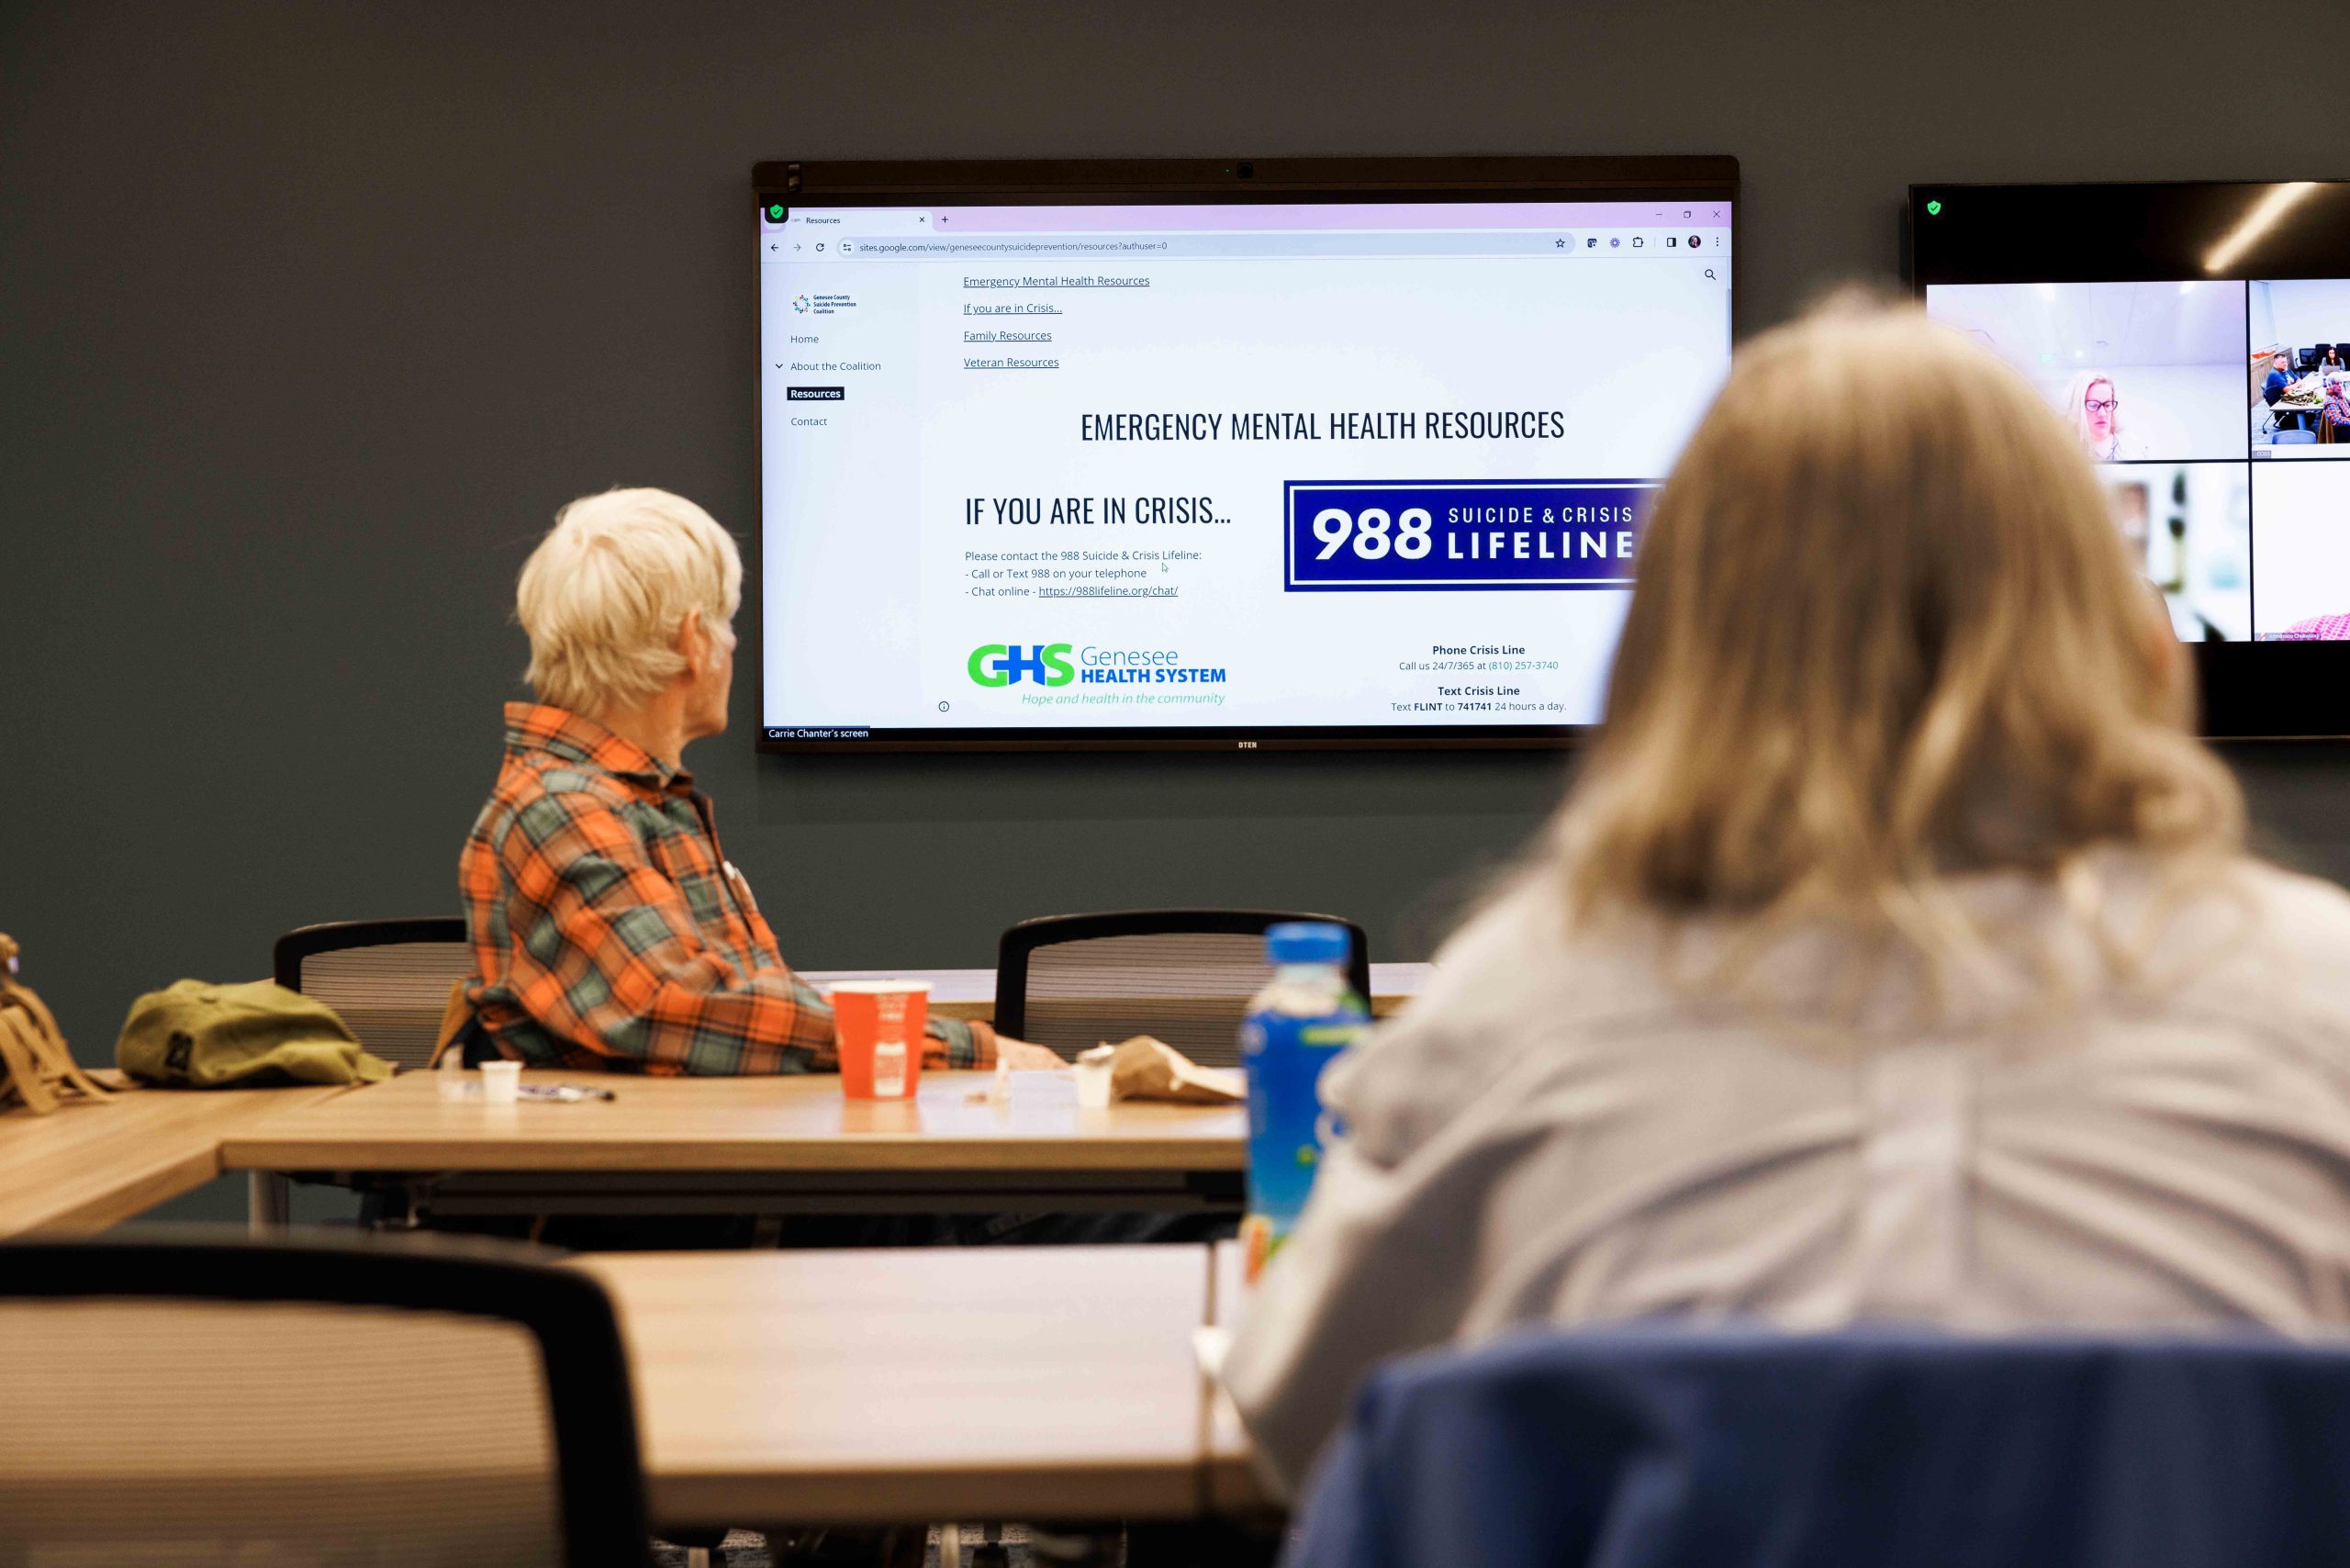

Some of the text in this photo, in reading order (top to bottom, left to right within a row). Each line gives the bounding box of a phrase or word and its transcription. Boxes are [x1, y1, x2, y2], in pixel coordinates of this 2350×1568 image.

[805, 217, 841, 225] Resources
[859, 241, 1168, 254] sites.google.com/view/geneseecountysuicideprevention/resources?authuser=0
[964, 276, 1150, 289] Emergency Mental Health Resources
[830, 299, 857, 308] Prevention
[833, 294, 851, 302] County
[964, 304, 971, 313] If
[973, 306, 992, 315] you
[1014, 304, 1024, 313] in
[1026, 303, 1062, 313] Crisis...
[790, 334, 820, 344] Home
[964, 330, 1052, 342] Family Resources
[789, 361, 881, 372] About the Coalition
[964, 357, 1059, 367] Veteran Resources
[790, 389, 841, 398] Resources
[790, 417, 828, 427] Contact
[1081, 410, 1565, 442] EMERGENCY MENTAL HEALTH RESOURCES
[966, 496, 1231, 525] IF YOU ARE IN CRISIS...
[1448, 507, 1632, 523] SUICIDE & CRISIS
[1313, 508, 1432, 560] 988
[1448, 532, 1633, 559] LIFELINE
[965, 550, 1202, 562] Please contact the 988 Suicide & Crisis Lifeline:
[971, 568, 990, 579] Call
[992, 571, 1004, 579] or
[1006, 568, 1029, 579] Text
[1031, 568, 1051, 579] 988
[1052, 570, 1067, 578] on
[1069, 570, 1093, 581] your
[1094, 567, 1147, 580] telephone
[971, 586, 996, 597] Chat
[997, 586, 1030, 597] online
[1038, 585, 1180, 599] https://988lifeline.org/chat/
[1080, 645, 1179, 666] Genesee
[1432, 644, 1526, 655] Phone Crisis Line
[967, 643, 1075, 688] GHS
[1399, 661, 1559, 672] Call us 24/7/365 at (810) 257-3740
[1080, 667, 1226, 684] HEALTH SYSTEM
[1437, 685, 1520, 696] Text Crisis Line
[1022, 692, 1226, 706] Hope and health in the community
[1391, 702, 1412, 711] Text
[1414, 702, 1443, 711] FLINT
[1445, 703, 1456, 711] to
[1457, 702, 1492, 711] 741741
[1494, 701, 1507, 711] 24
[1508, 701, 1537, 711] hours
[1547, 701, 1567, 713] day.
[768, 728, 868, 738] Carrie Chanter's screen
[1237, 741, 1258, 749] DTEN
